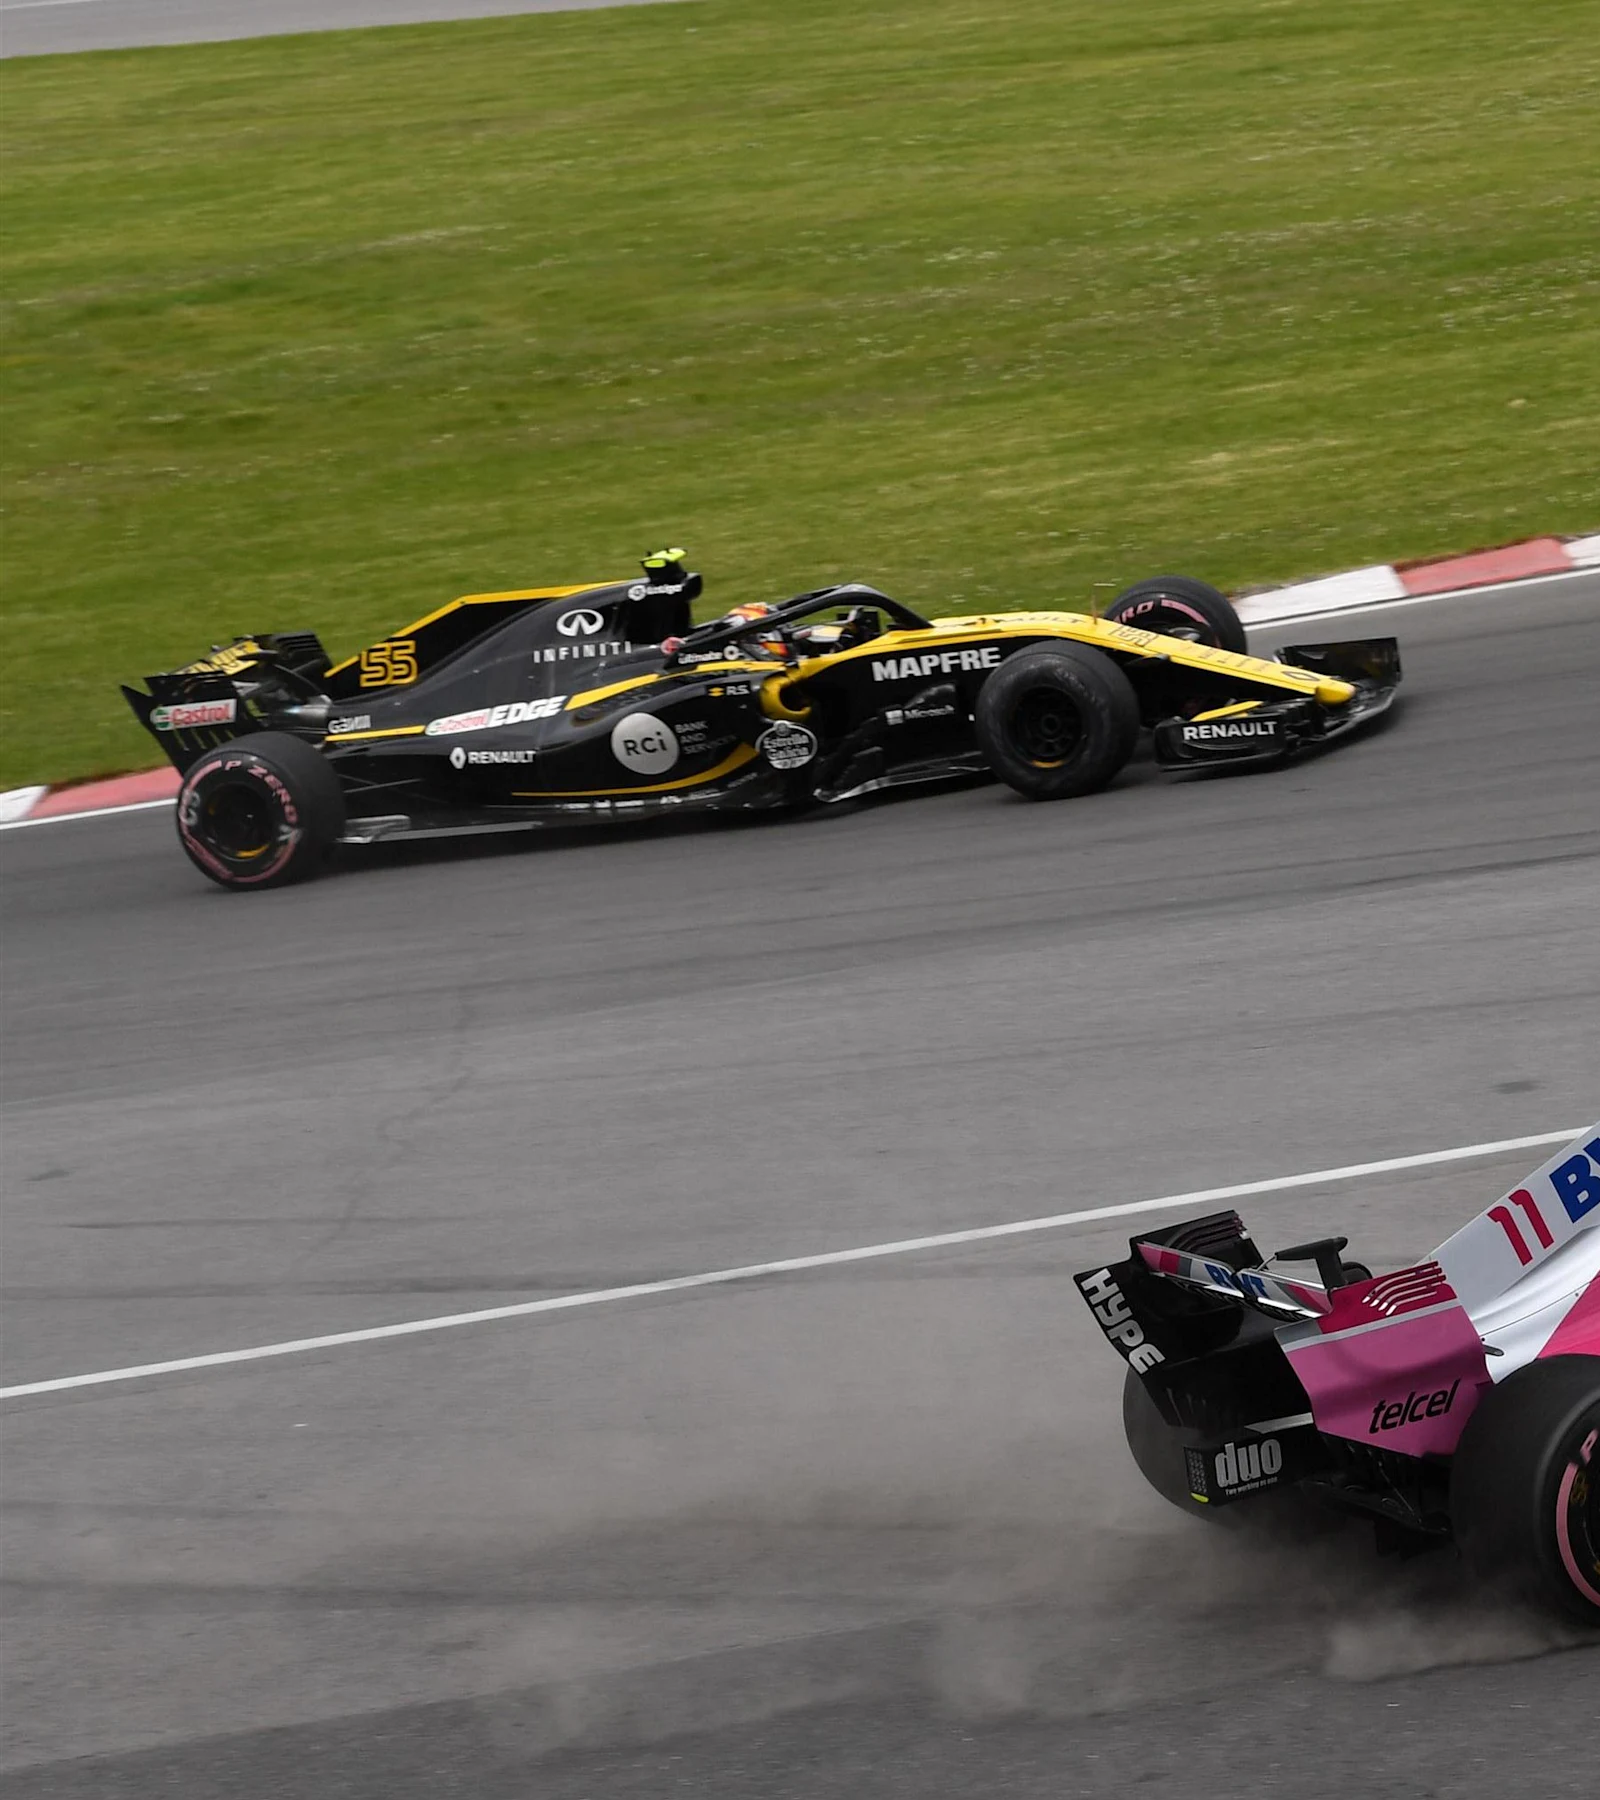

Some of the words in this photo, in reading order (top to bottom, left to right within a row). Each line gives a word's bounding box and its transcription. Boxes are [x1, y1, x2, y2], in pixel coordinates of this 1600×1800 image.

[360, 640, 417, 687] 55
[533, 641, 632, 663] INFINITI
[871, 647, 1000, 682] MAPFRE
[172, 703, 230, 725] Castrol
[490, 695, 567, 725] EDGE
[674, 720, 708, 734] BANK
[680, 733, 706, 744] AND
[1182, 721, 1277, 741] RENAULT
[622, 731, 667, 756] RCi
[763, 733, 809, 749] Estrella
[766, 746, 809, 760] Galicia
[468, 750, 536, 765] RENAULT
[247, 764, 298, 824] ZERO
[1486, 1188, 1554, 1267] 11
[1081, 1268, 1165, 1375] HYPE
[1368, 1379, 1461, 1434] telcel
[1580, 1428, 1599, 1464] P
[1214, 1439, 1282, 1488] duo
